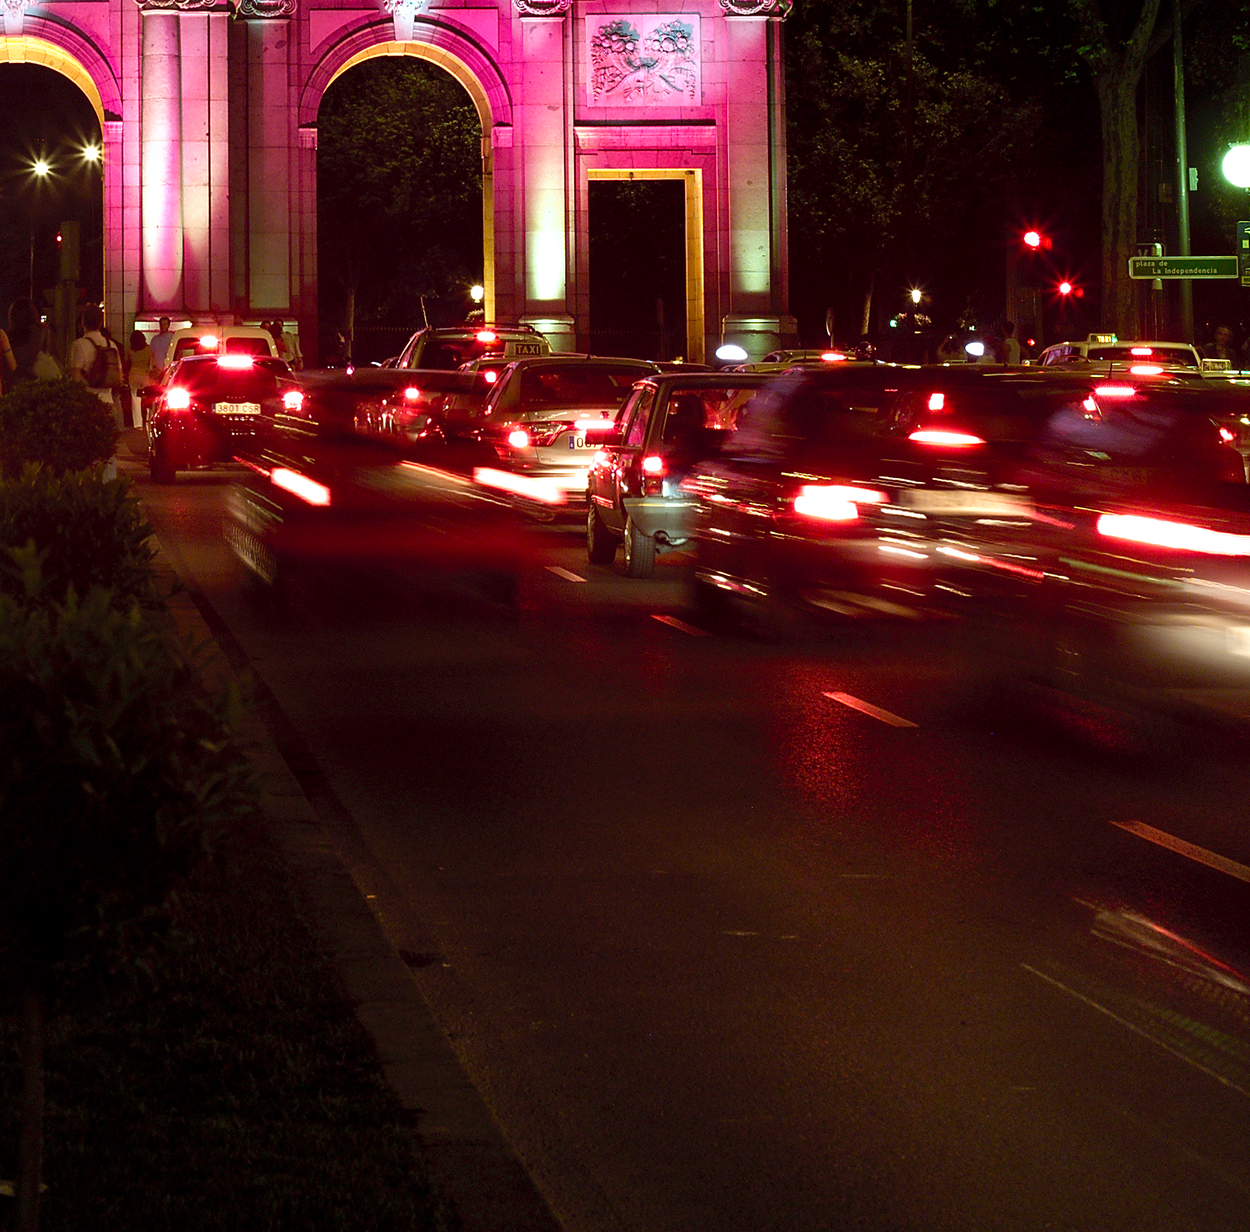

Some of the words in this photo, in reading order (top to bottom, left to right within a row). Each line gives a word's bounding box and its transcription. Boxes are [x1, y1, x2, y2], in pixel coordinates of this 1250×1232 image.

[1136, 260, 1155, 268] plaza
[1164, 267, 1218, 275] Independencia
[516, 345, 539, 355] TAXI
[217, 404, 239, 413] 3801
[242, 404, 260, 413] CSR
